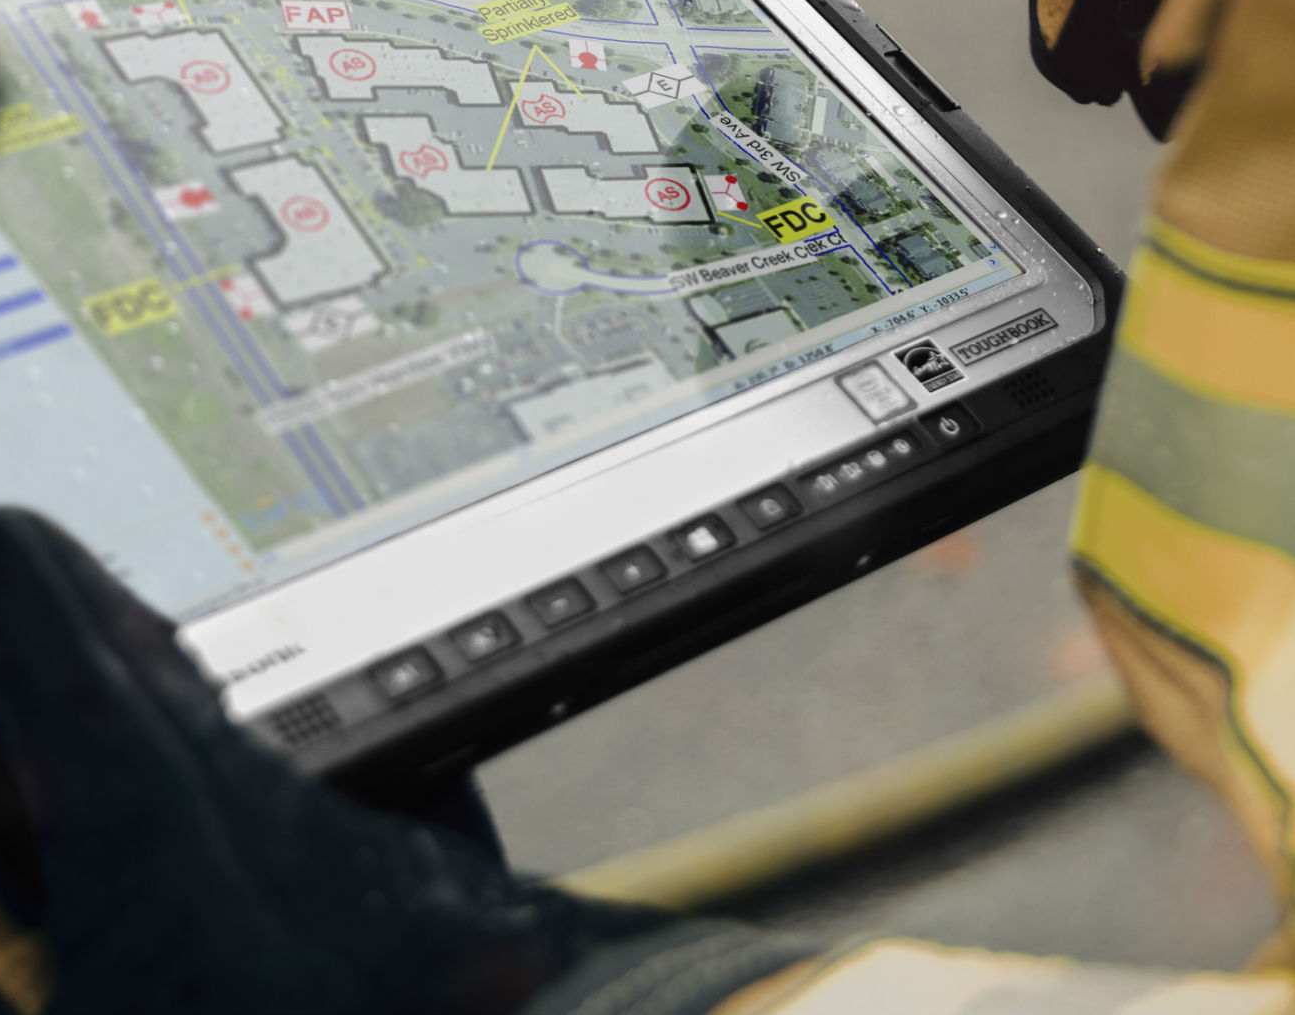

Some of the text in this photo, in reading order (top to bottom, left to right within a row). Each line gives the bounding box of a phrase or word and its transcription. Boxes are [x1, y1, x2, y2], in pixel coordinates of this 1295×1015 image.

[284, 5, 346, 25] FAP
[481, 4, 578, 42] Sprinklered
[341, 55, 367, 74] AS
[532, 101, 557, 117] AS
[720, 113, 801, 183] SW 3rd Ave.
[655, 185, 681, 203] AS
[762, 202, 827, 239] FDC
[669, 272, 699, 290] SW
[699, 261, 751, 283] Beaver
[750, 249, 795, 270] Creek
[956, 313, 1052, 360] TOUGHBOOK
